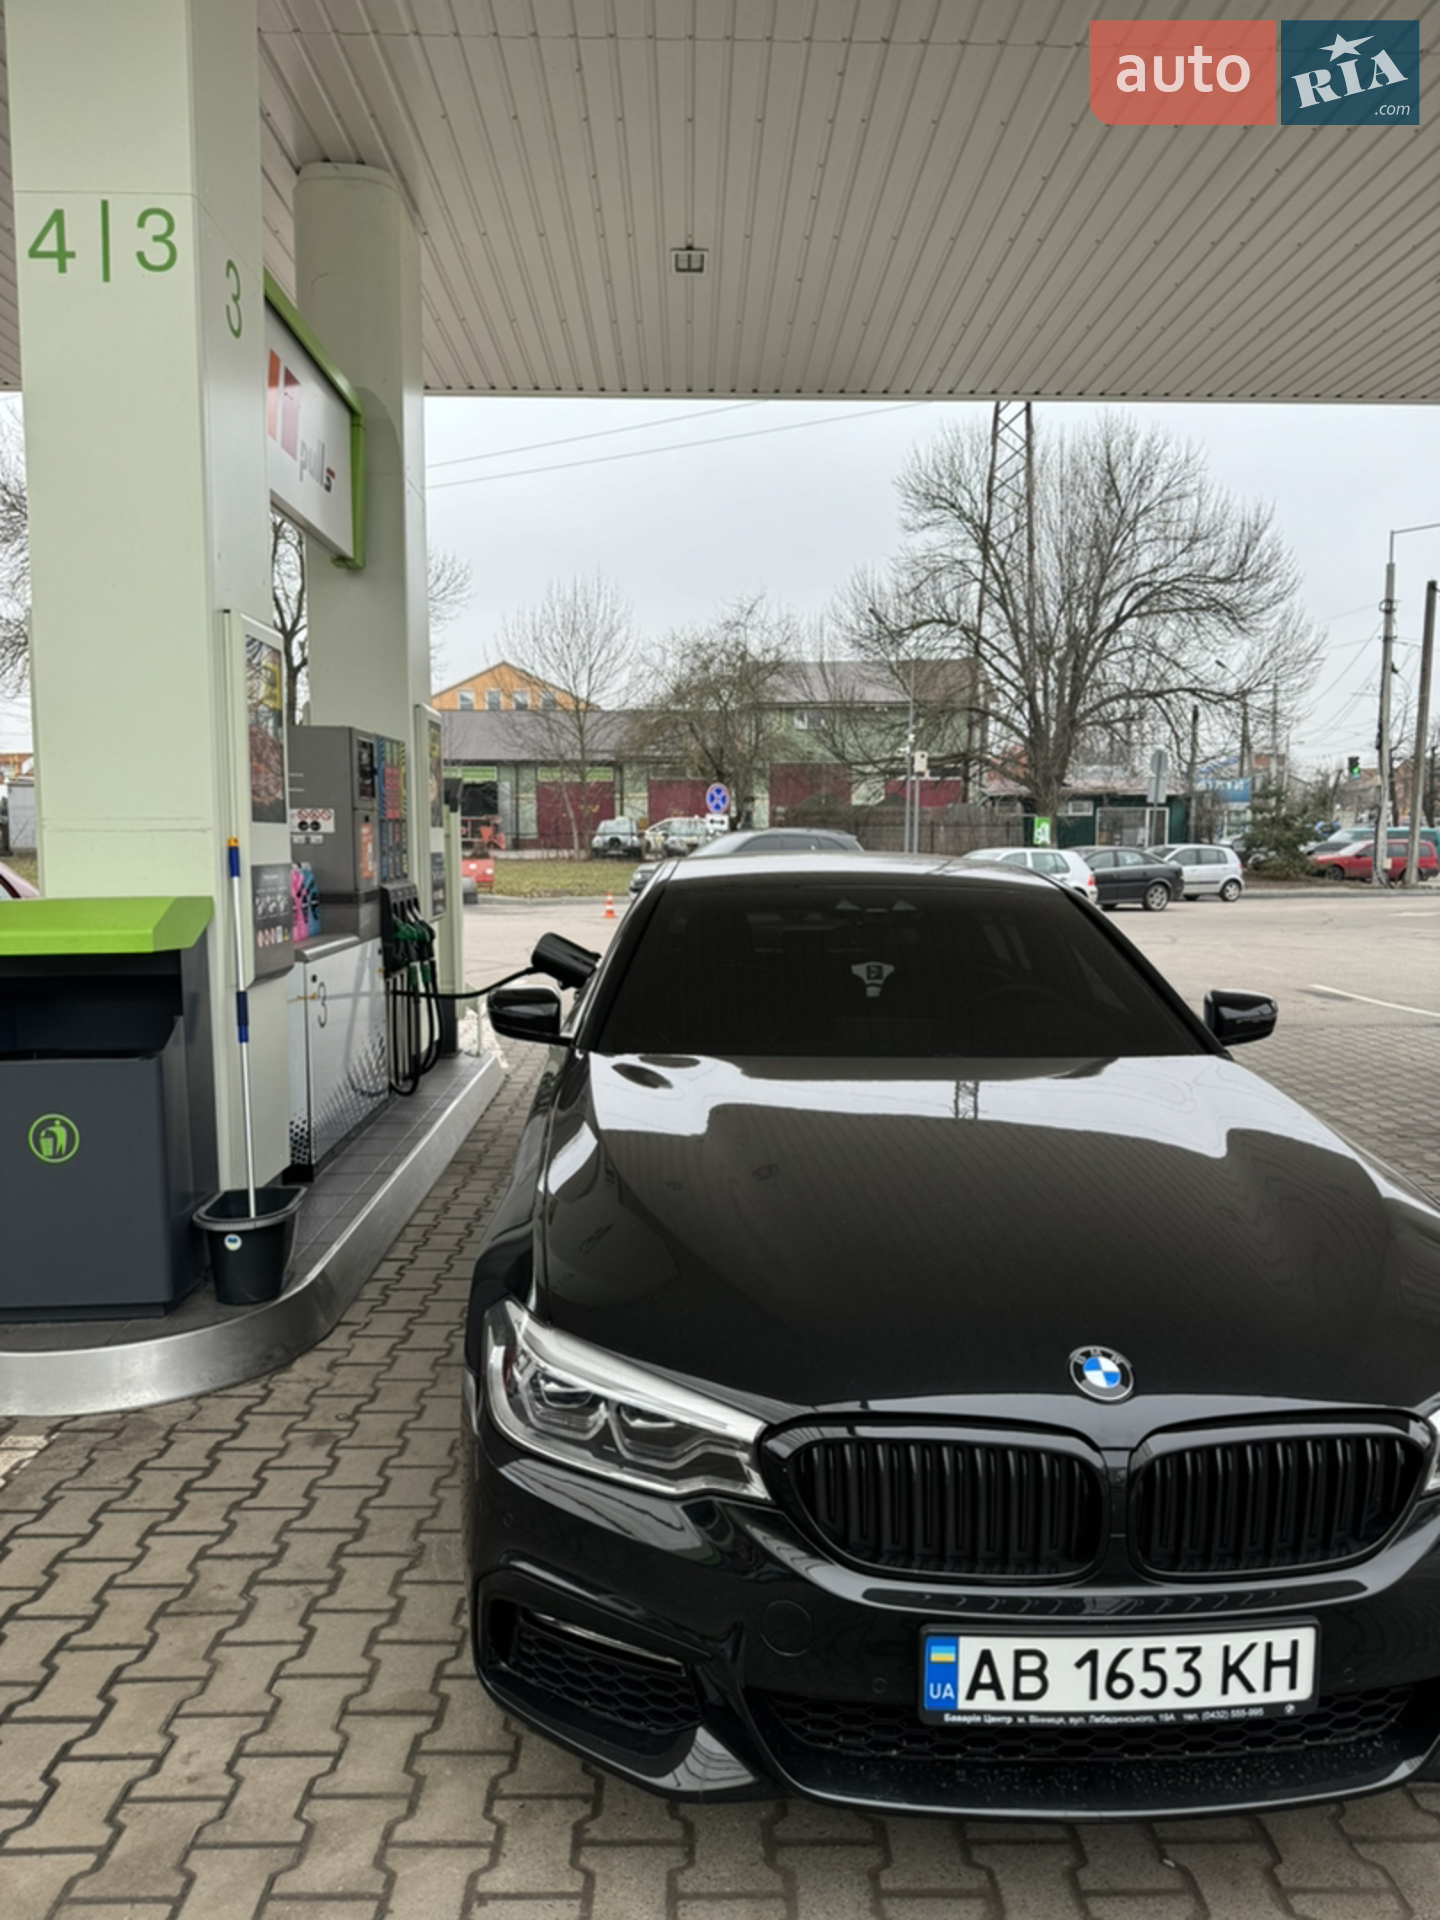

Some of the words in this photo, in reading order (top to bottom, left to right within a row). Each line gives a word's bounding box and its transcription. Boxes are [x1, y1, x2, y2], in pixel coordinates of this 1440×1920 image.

[225, 259, 243, 339] 3
[299, 439, 336, 493] pulls
[317, 981, 328, 1029] 3
[929, 1682, 955, 1700] UA
[965, 1649, 1049, 1701] AB
[1073, 1645, 1203, 1701] 1653
[1221, 1639, 1299, 1697] KH
